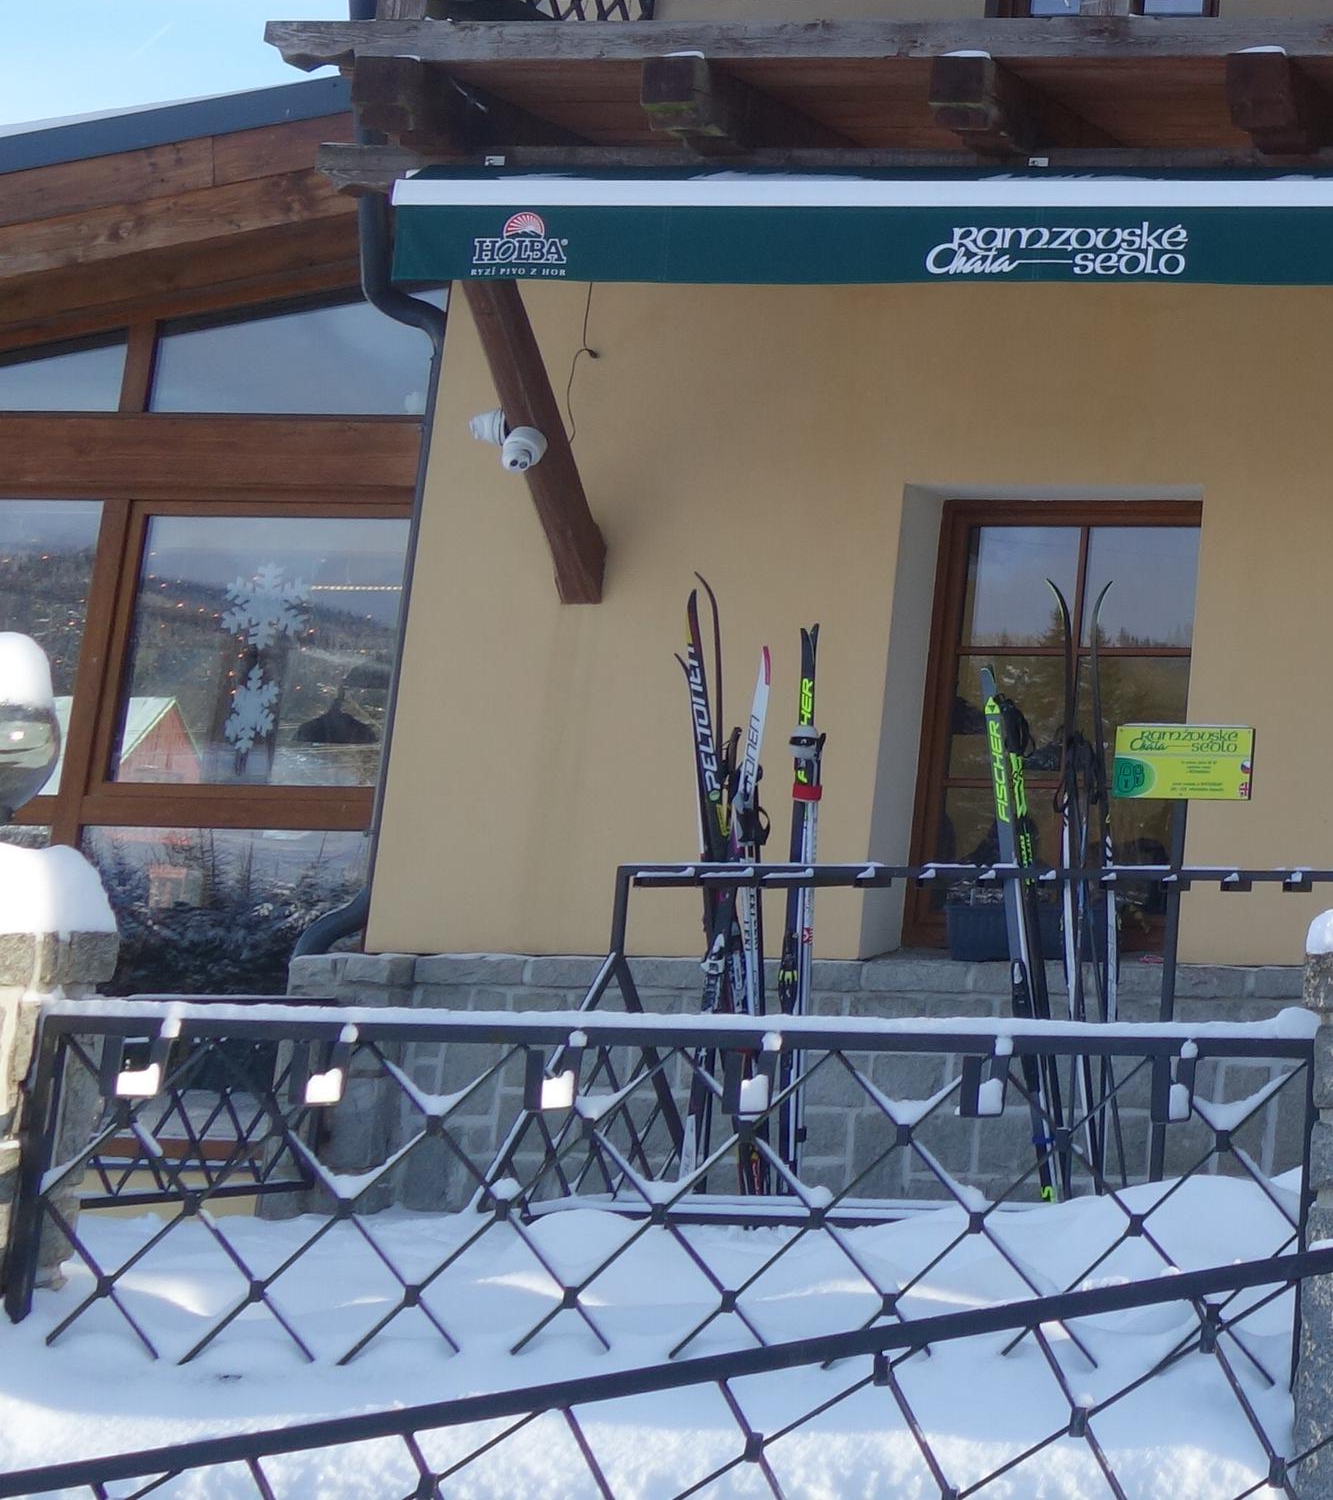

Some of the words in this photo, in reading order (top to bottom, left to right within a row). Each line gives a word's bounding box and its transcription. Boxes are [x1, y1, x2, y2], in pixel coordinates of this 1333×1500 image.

[472, 238, 567, 264] HOLBA
[926, 243, 1019, 275] Chata
[500, 268, 526, 276] PIVO
[530, 268, 537, 276] Z
[542, 268, 567, 276] HOR
[988, 719, 1010, 823] FISCHER
